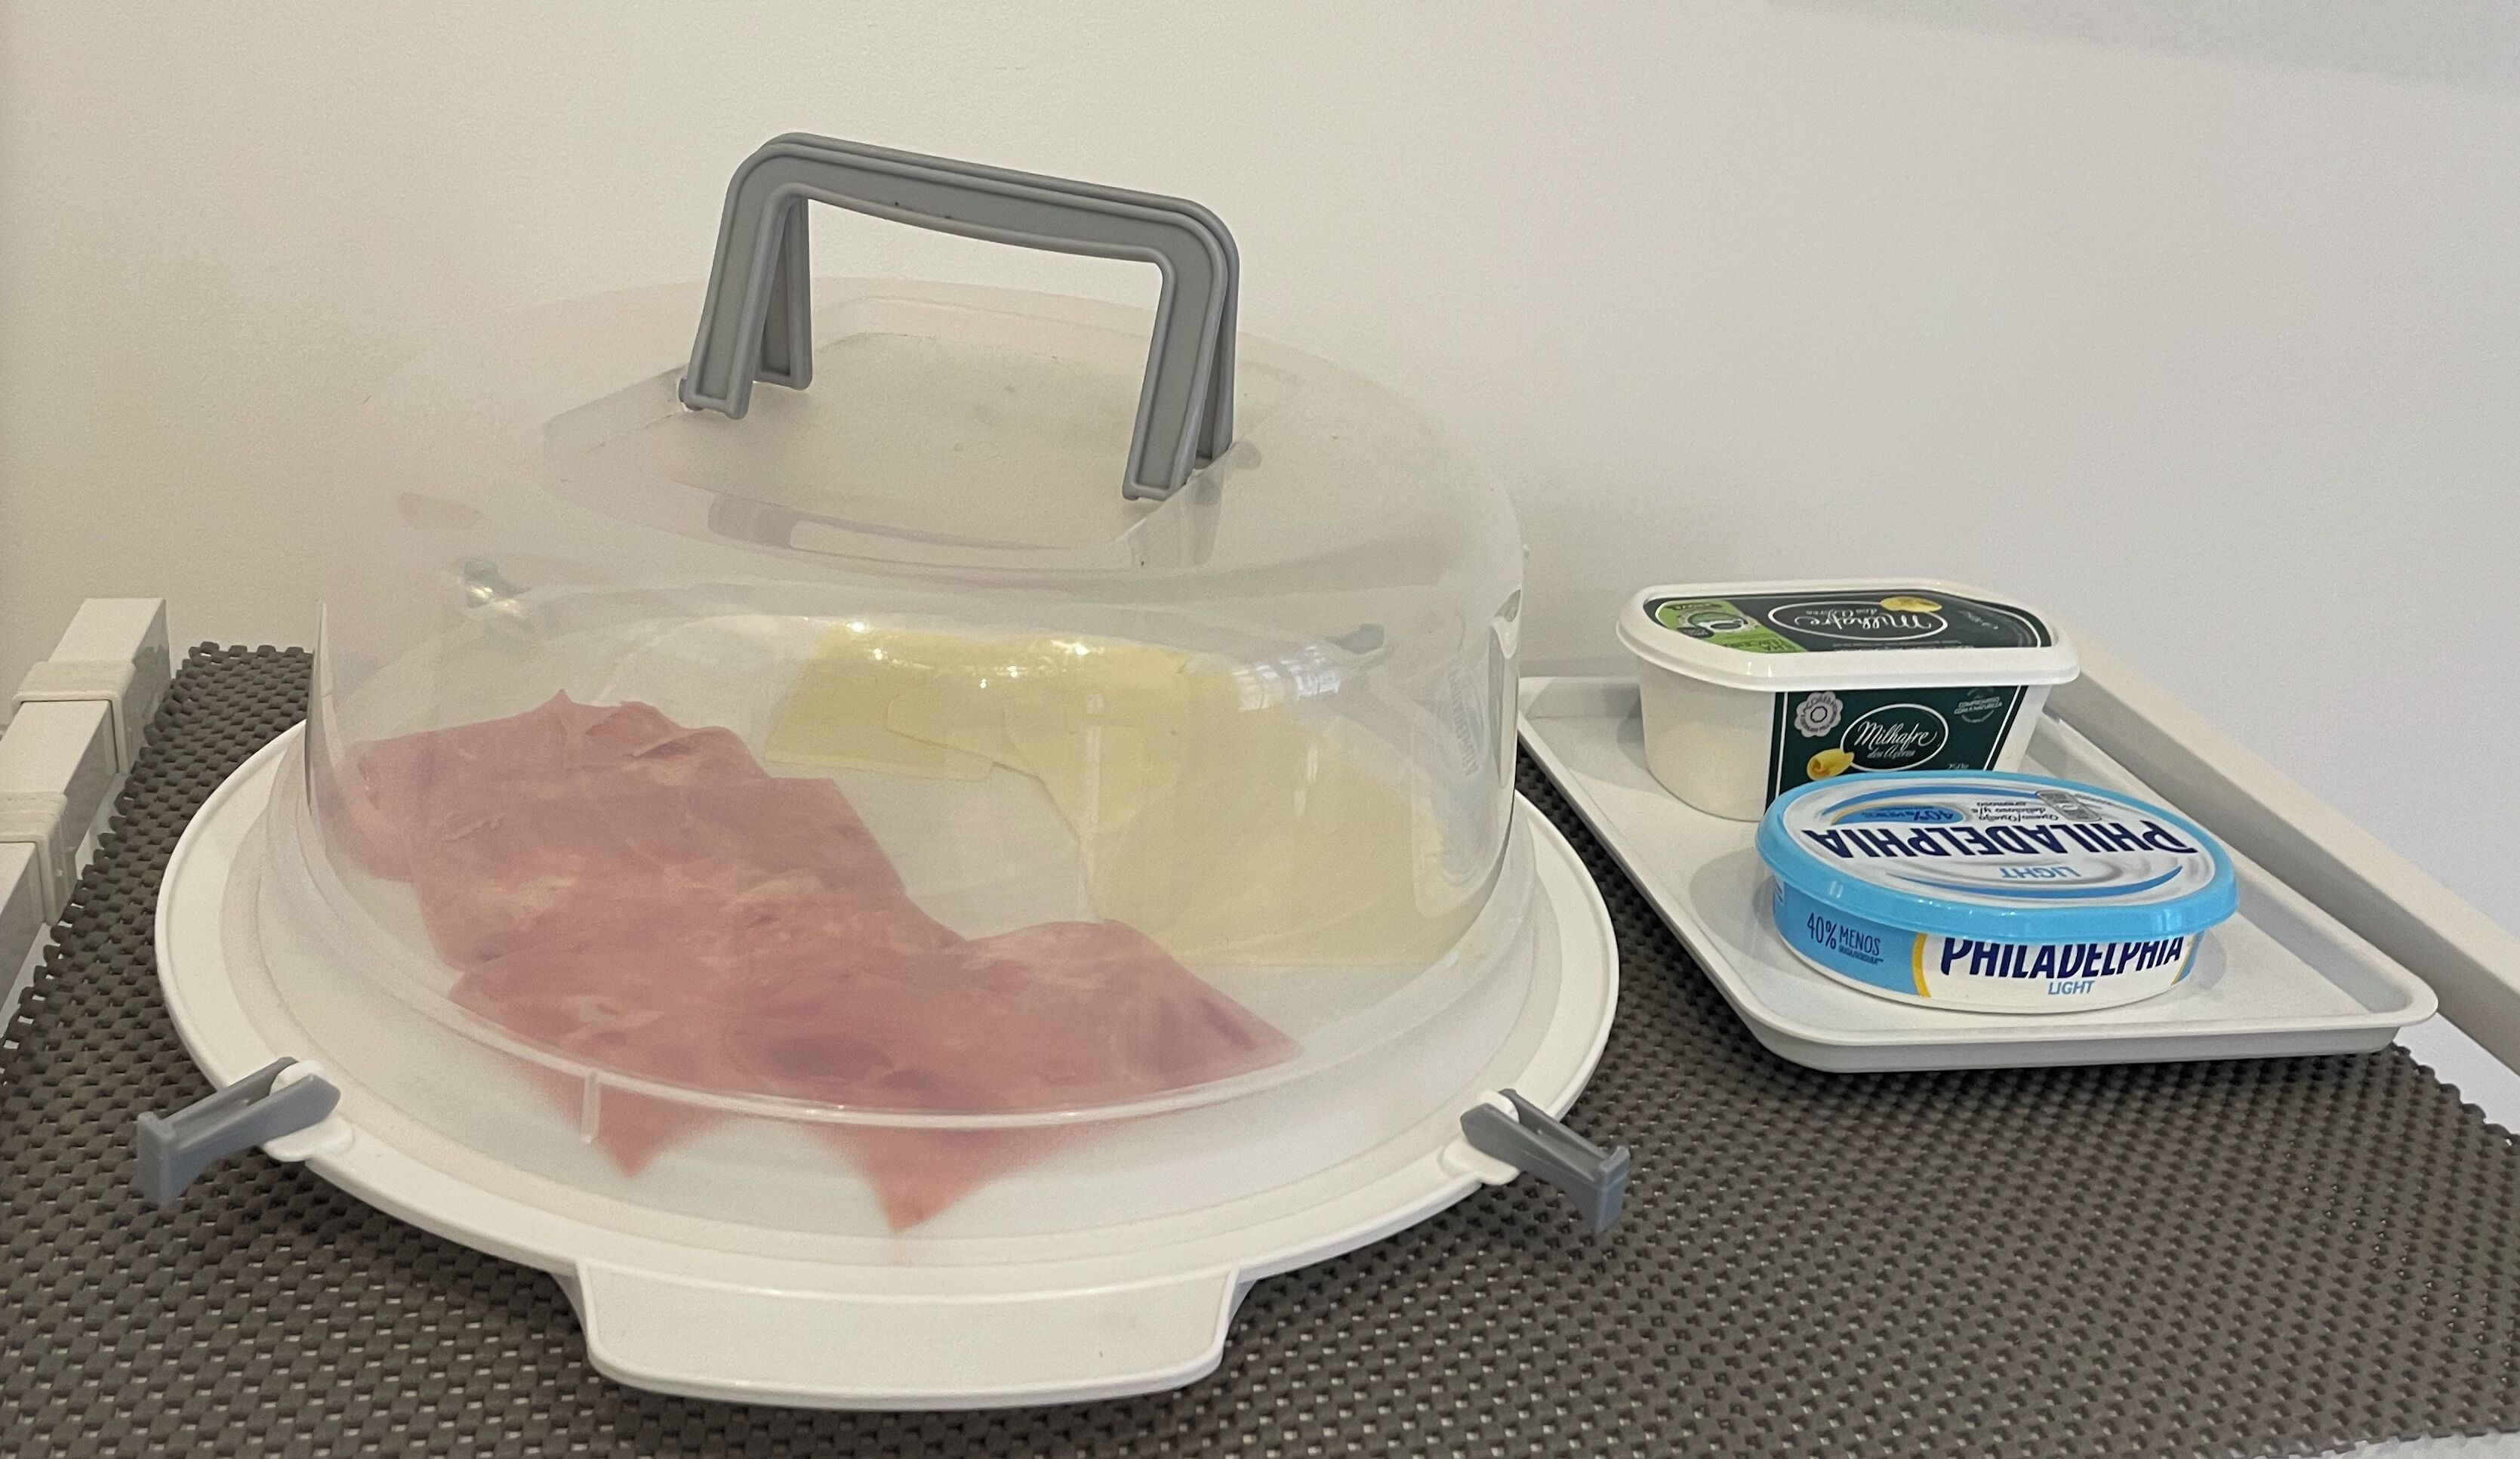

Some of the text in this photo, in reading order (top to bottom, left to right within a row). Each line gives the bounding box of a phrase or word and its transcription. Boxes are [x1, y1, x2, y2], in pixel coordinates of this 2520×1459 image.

[1794, 609, 1932, 630] Milhafre
[1854, 720, 1938, 751] Milhafre
[1803, 821, 2198, 859] PHILADELPHIA
[1999, 865, 2082, 880] LIGHT
[1807, 911, 1838, 950] 40%
[1839, 925, 1881, 956] MENOS
[1940, 936, 2185, 979] PHILADELPHIA
[2047, 981, 2096, 995] LIGHT
